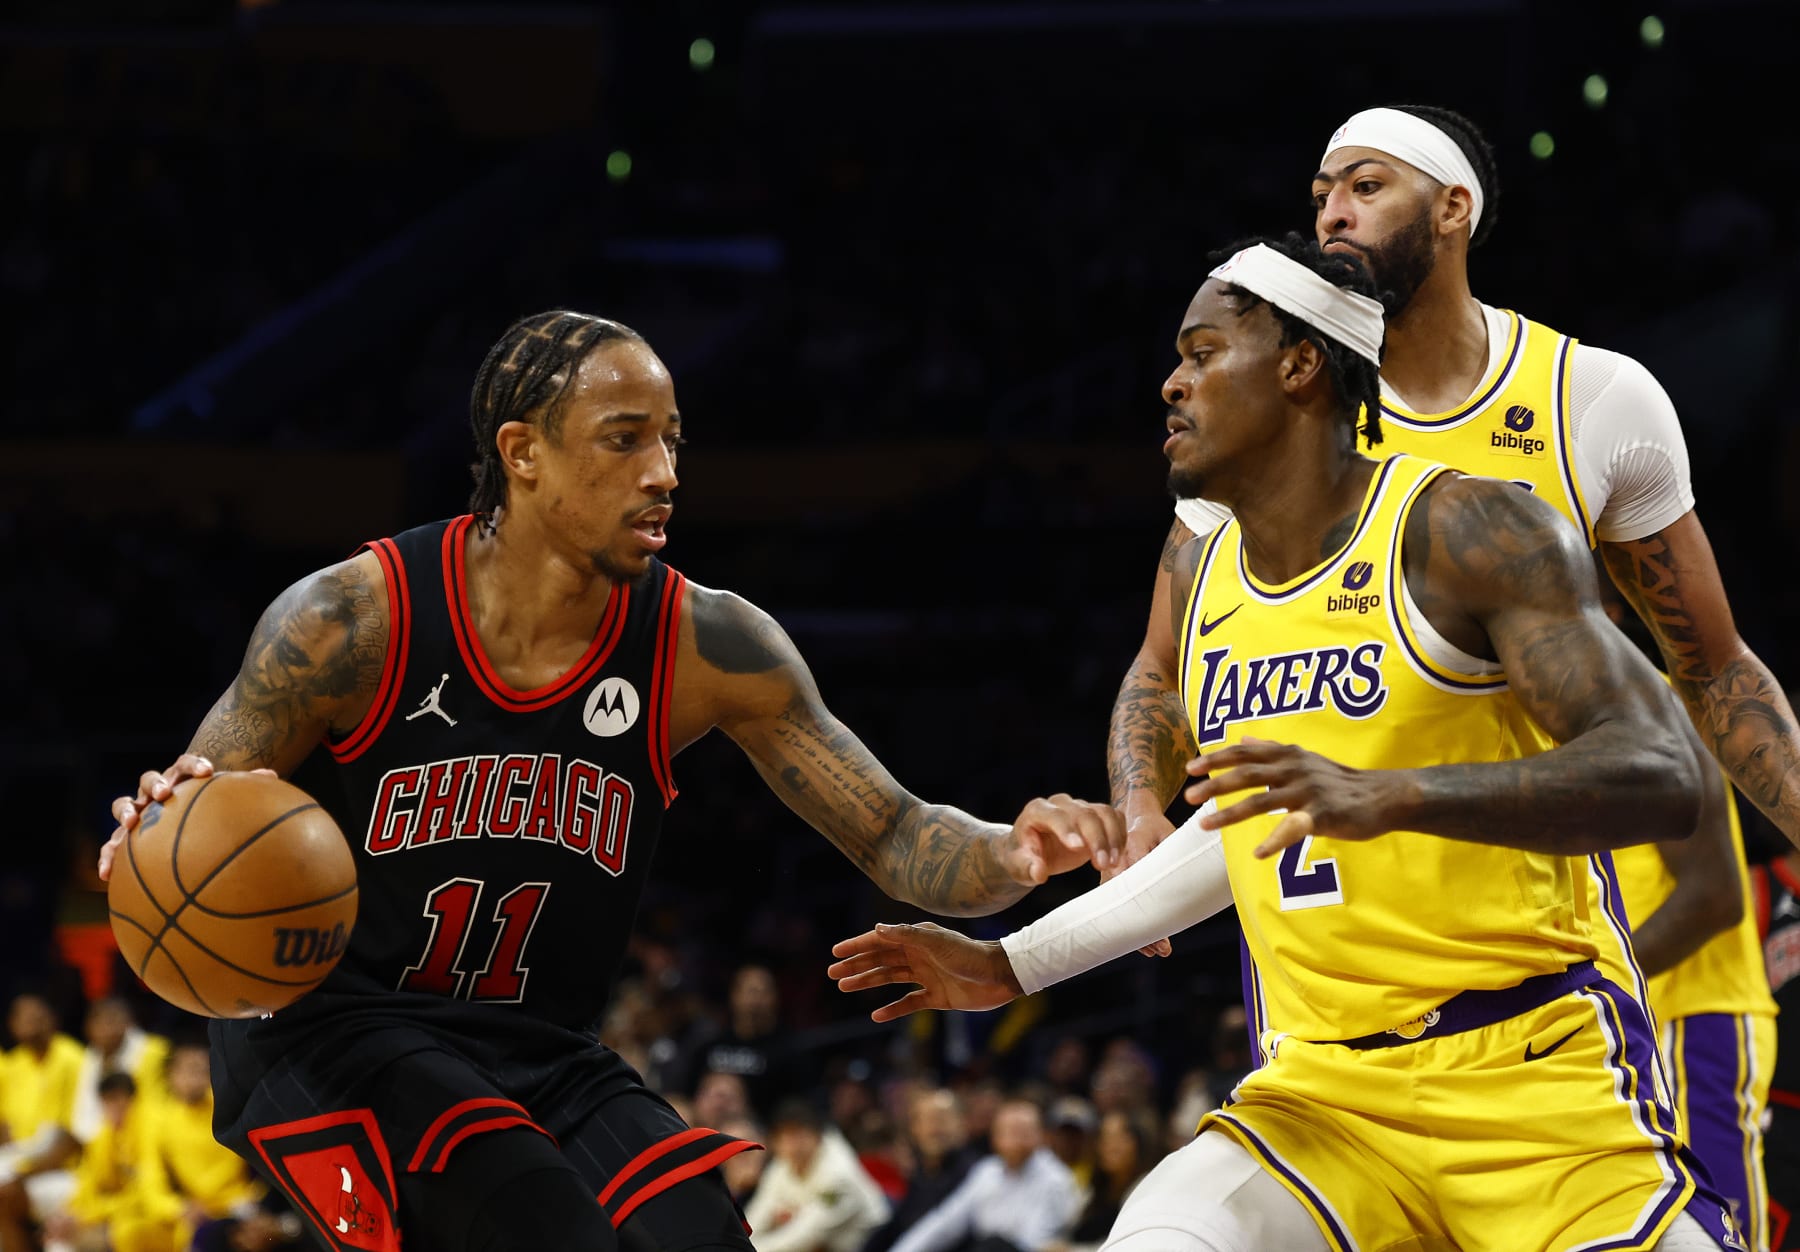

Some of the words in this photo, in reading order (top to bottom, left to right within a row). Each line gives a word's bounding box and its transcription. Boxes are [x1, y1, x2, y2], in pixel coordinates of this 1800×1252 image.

[1491, 432, 1544, 455] bibigo
[1327, 594, 1380, 615] bibigo
[1197, 640, 1390, 748] LAKERS
[364, 753, 634, 877] CHICAGO
[396, 877, 551, 1003] 11
